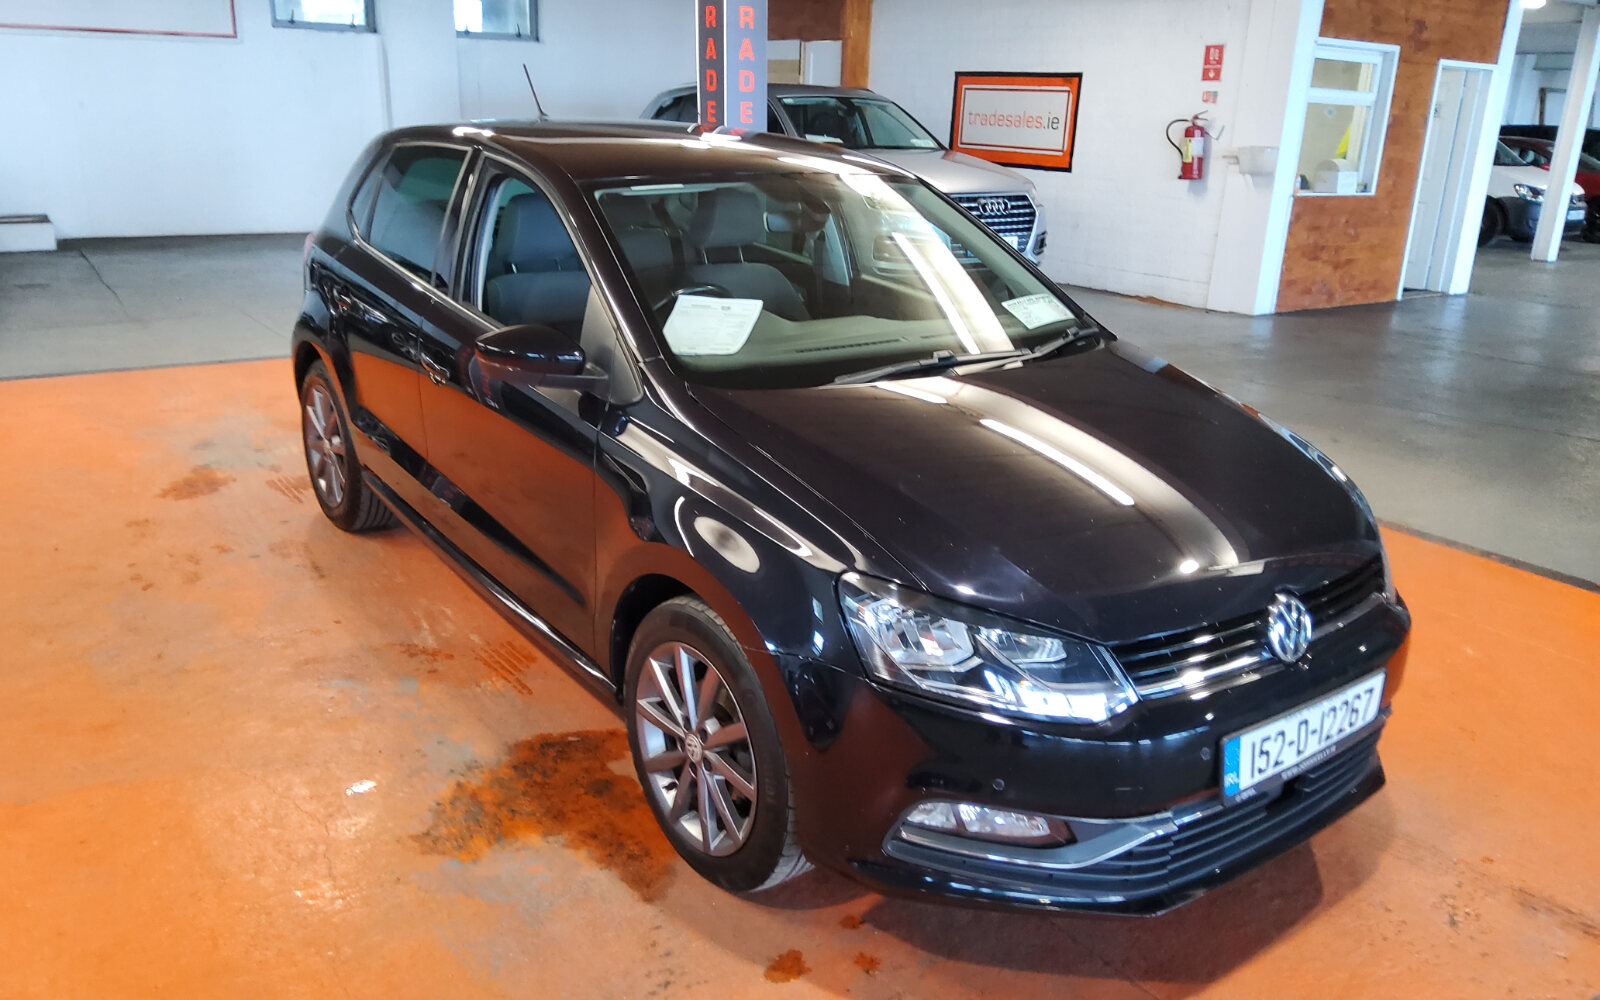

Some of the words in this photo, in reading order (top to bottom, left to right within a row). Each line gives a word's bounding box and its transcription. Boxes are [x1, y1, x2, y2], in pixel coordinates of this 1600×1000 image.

[705, 5, 717, 123] RADE
[738, 5, 755, 123] RADE
[968, 110, 1060, 130] tradesales.ie
[1250, 687, 1375, 779] 152-D-12267
